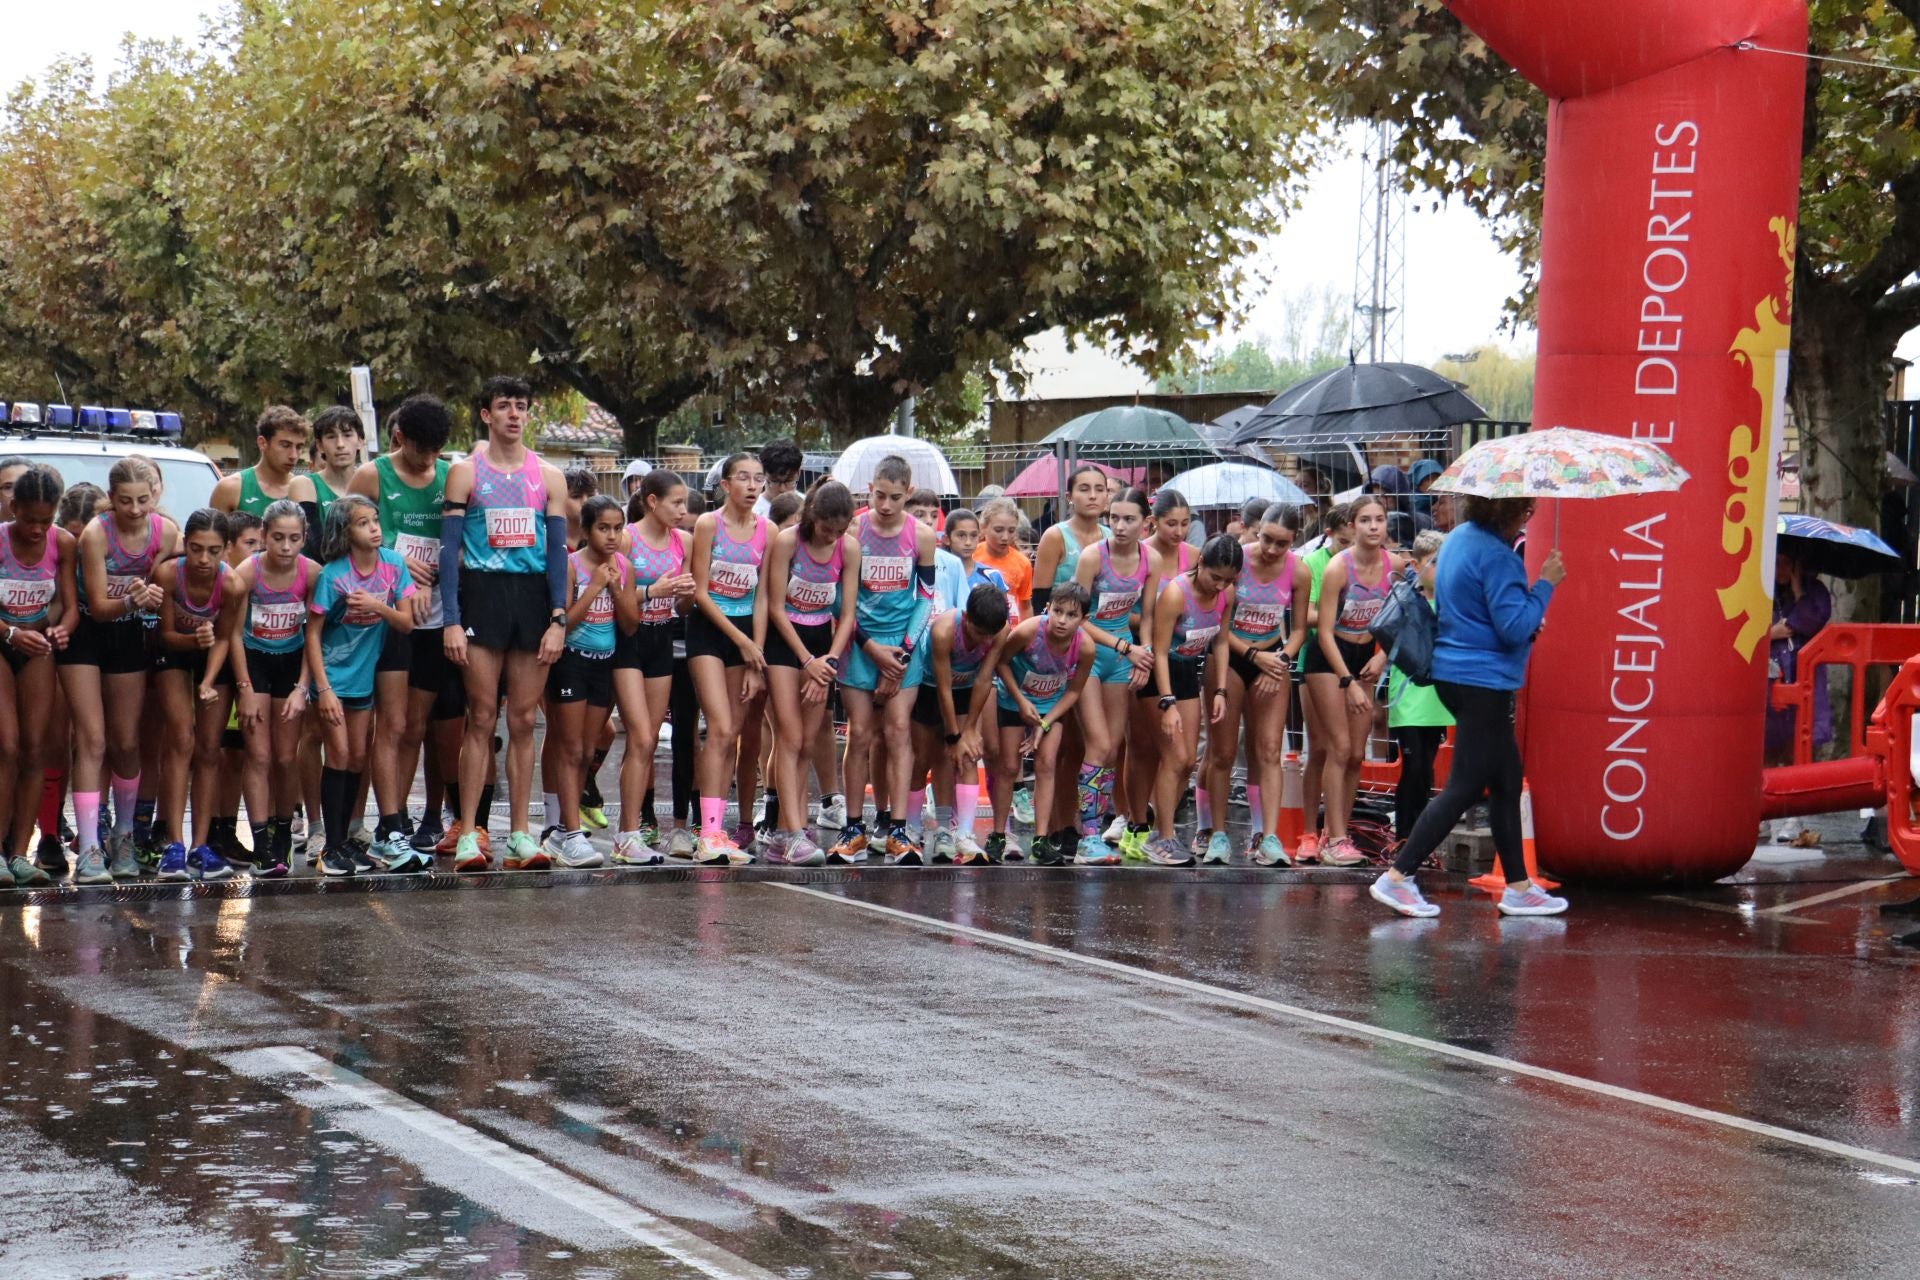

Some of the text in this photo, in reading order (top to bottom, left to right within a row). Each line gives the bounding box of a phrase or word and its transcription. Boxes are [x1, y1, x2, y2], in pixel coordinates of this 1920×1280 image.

[1600, 512, 1667, 841] CONCEJALÍA
[1634, 120, 1699, 395] DEPORTES
[403, 511, 442, 520] universida
[494, 517, 528, 535] 2007
[406, 544, 433, 564] 2012
[716, 569, 750, 589] 2044
[870, 565, 904, 581] 2006
[7, 589, 47, 606] 2042
[793, 586, 829, 605] 2053
[261, 611, 299, 630] 2079
[1243, 609, 1277, 626] 2048
